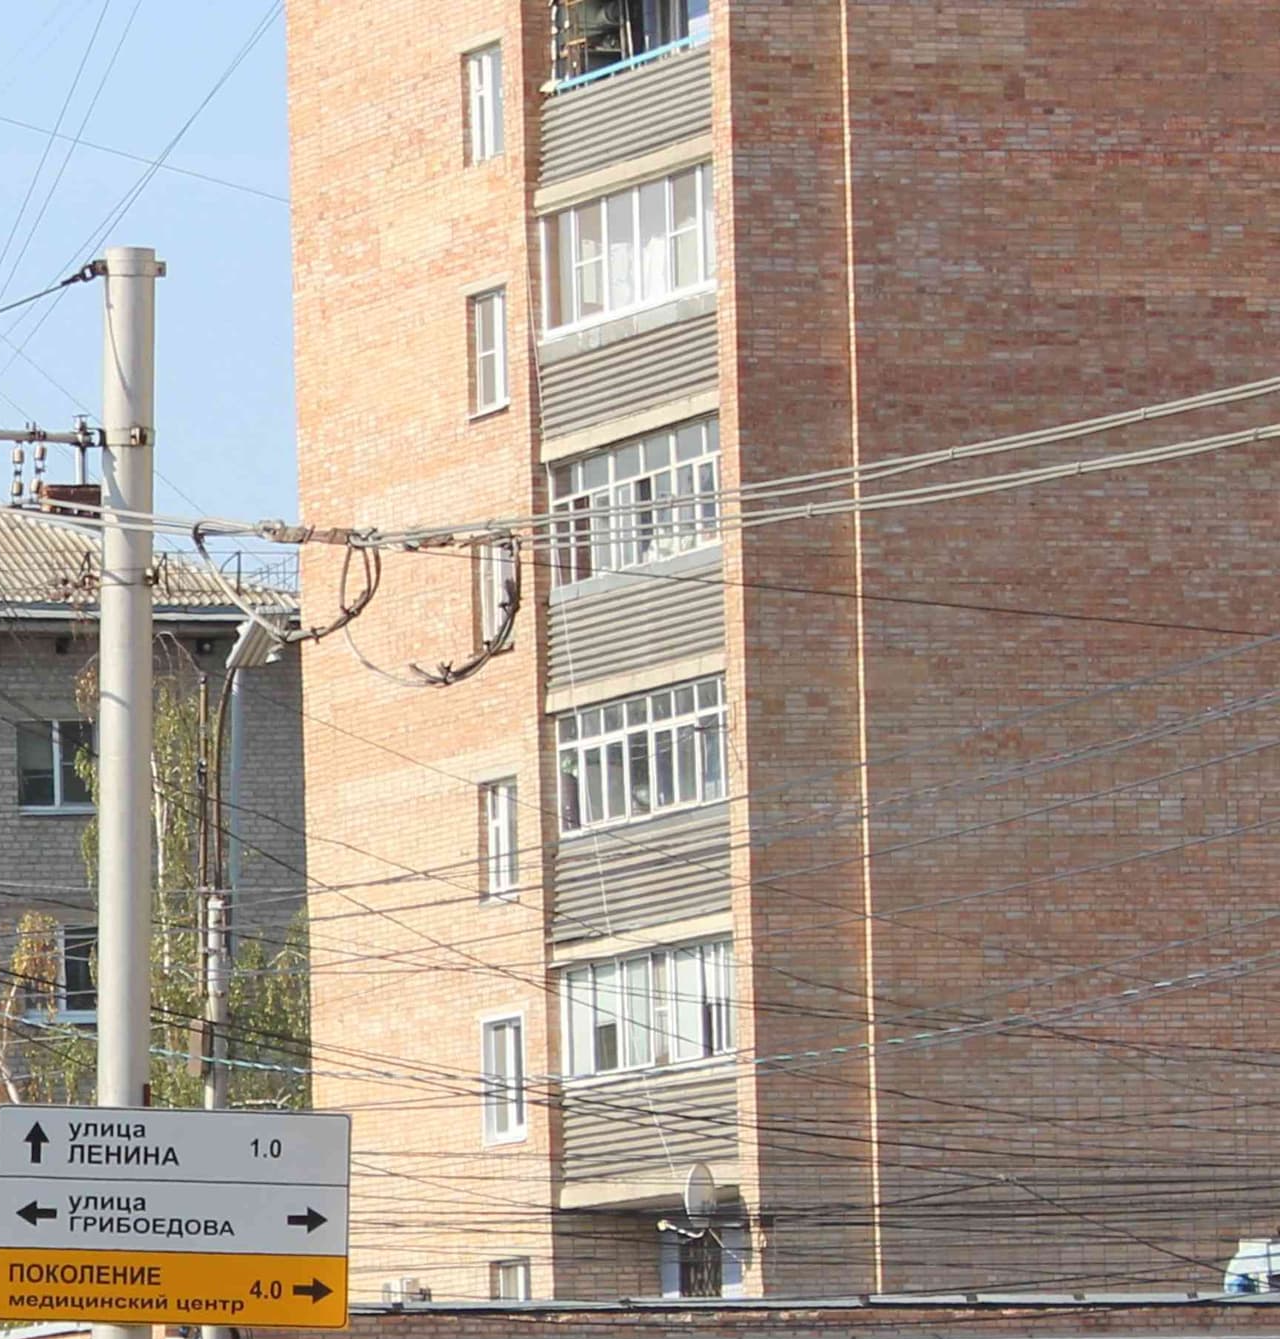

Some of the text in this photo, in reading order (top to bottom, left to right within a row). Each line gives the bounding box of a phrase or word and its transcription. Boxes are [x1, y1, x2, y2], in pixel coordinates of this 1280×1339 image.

[68, 1121, 147, 1141] улица
[67, 1138, 282, 1167] ЛЕНИНА 1.0
[68, 1194, 147, 1214] улица
[68, 1216, 235, 1238] ГРИБОЕДОВА
[8, 1262, 162, 1287] ПОКОЛЕНИЕ
[249, 1280, 282, 1300] 4.0
[8, 1293, 245, 1316] медицинский центр
